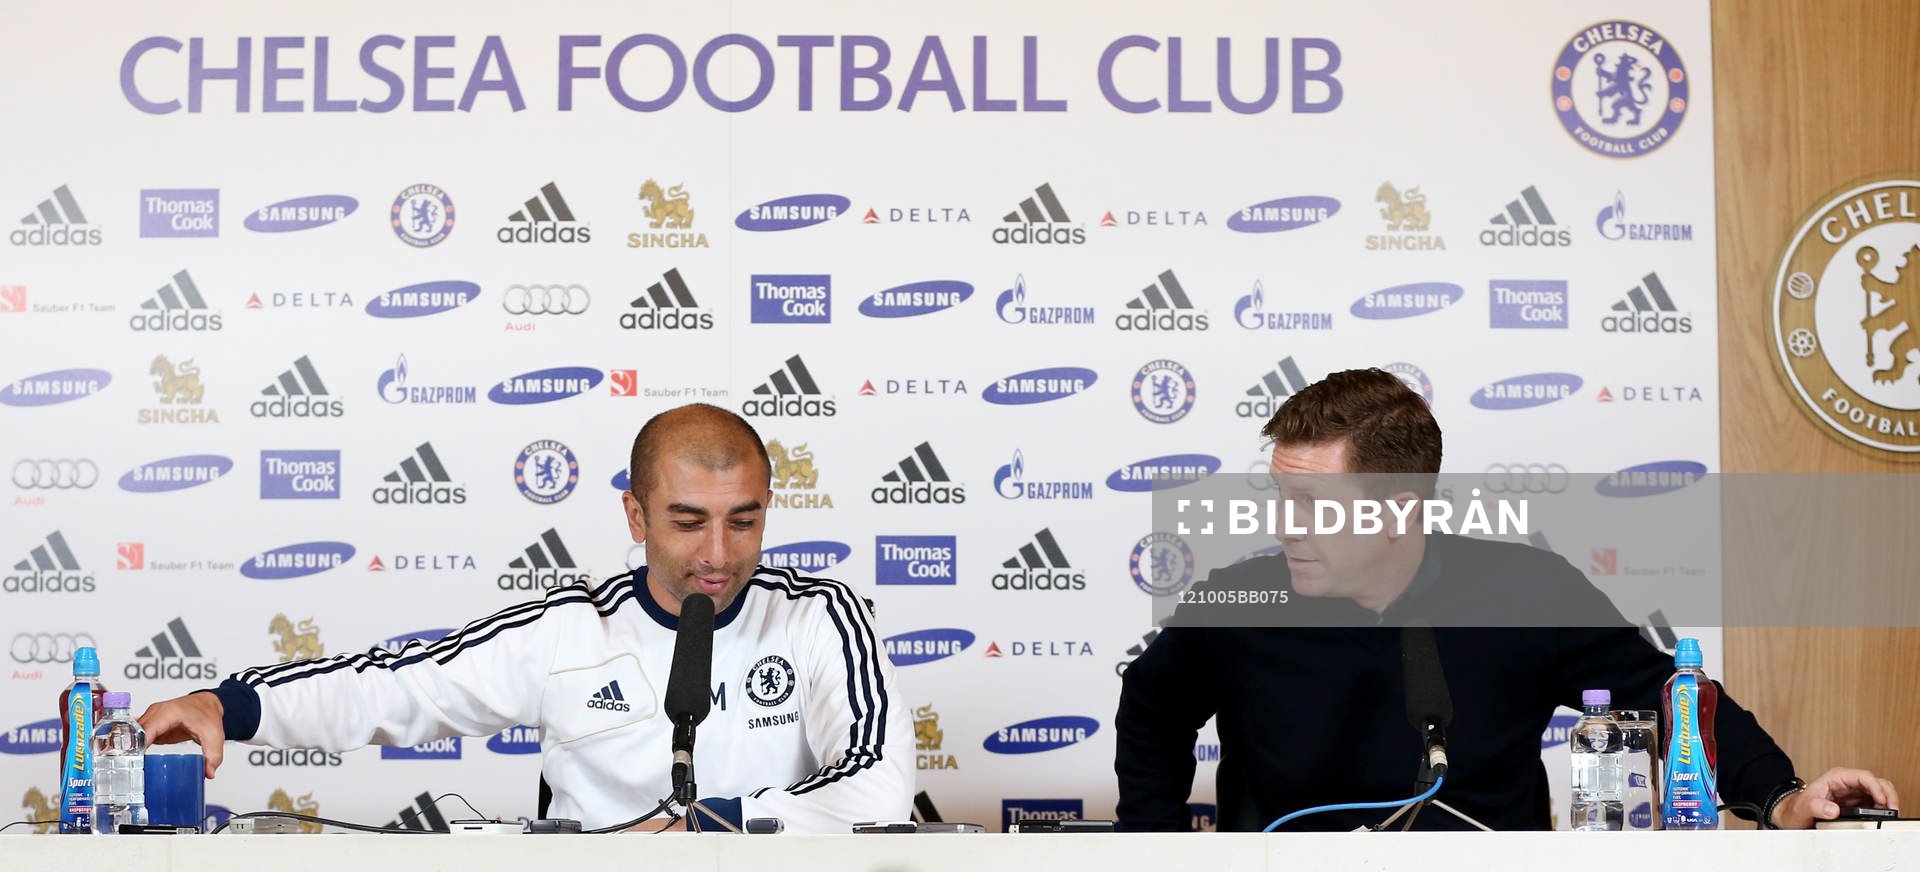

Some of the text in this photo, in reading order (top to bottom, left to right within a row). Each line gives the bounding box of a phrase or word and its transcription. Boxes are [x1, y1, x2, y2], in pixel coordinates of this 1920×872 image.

[1572, 23, 1664, 55] CHELSEA
[119, 33, 1344, 115] CHELSEA FOOTBALL CLUB
[1574, 126, 1668, 153] FOOTBALL CLUB
[145, 197, 214, 214] Thomas
[750, 206, 837, 221] SAMSUNG
[259, 206, 345, 222] SAMSUNG
[890, 208, 971, 222] DELTA
[1128, 211, 1208, 225] DELTA
[1241, 207, 1328, 222] SAMSUNG
[1821, 192, 1920, 243] CHEL
[172, 214, 213, 231] Cook
[10, 224, 102, 246] adidas
[497, 222, 591, 243] adidas
[992, 222, 1086, 244] adidas
[1480, 224, 1571, 247] adidas
[1629, 223, 1693, 241] GAZPROM
[627, 233, 709, 249] SINGHA
[1365, 235, 1446, 251] SINGHA
[756, 282, 826, 300] Thomas
[1494, 288, 1563, 305] Thomas
[33, 303, 116, 312] Sauber F1 Team
[273, 293, 353, 307] DELTA
[380, 292, 468, 307] SAMSUNG
[873, 292, 960, 307] SAMSUNG
[1364, 294, 1451, 309] SAMSUNG
[782, 300, 826, 317] Cook
[1029, 307, 1095, 324] GAZPROM
[1521, 305, 1562, 322] Cook
[130, 309, 222, 331] adidas
[505, 321, 536, 332] Audi
[620, 307, 713, 330] adidas
[1115, 309, 1208, 331] adidas
[1268, 312, 1333, 330] GAZPROM
[1601, 311, 1692, 334] adidas
[12, 380, 98, 396] SAMSUNG
[502, 378, 590, 394] SAMSUNG
[644, 387, 729, 397] Sauber F1 Team
[887, 380, 967, 394] DELTA
[997, 378, 1085, 394] SAMSUNG
[1484, 384, 1570, 399] SAMSUNG
[1624, 387, 1702, 401] DELTA
[411, 386, 476, 404] GAZPROM
[250, 396, 343, 418] adidas
[742, 395, 836, 417] adidas
[1236, 396, 1276, 418] adi
[1822, 388, 1920, 436] FOOTBAL
[138, 409, 219, 424] SINGHA
[525, 441, 568, 455] CHELSEA
[133, 466, 220, 482] SAMSUNG
[266, 458, 335, 476] Thomas
[1121, 466, 1208, 481] SAMSUNG
[292, 475, 335, 493] Cook
[1609, 472, 1694, 486] SAMSUNG
[372, 482, 466, 504] adidas
[871, 481, 966, 504] adidas
[1027, 482, 1093, 500] GAZPROM
[14, 496, 45, 505] Audi
[767, 493, 834, 509] NGHA
[255, 553, 342, 568] SAMSUNG
[762, 553, 837, 567] AMSUNG
[881, 544, 951, 561] Thomas
[150, 561, 234, 570] Sauber F1 Team
[396, 555, 476, 570] DELTA
[907, 561, 951, 577] Cook
[3, 570, 96, 593] adidas
[992, 567, 1085, 591] adidas
[886, 640, 961, 654] AMSUNG
[1012, 642, 1093, 656] DELTA
[12, 670, 43, 680] Audi
[124, 657, 218, 680] adidas
[587, 698, 630, 712] adidas
[748, 711, 799, 729] SAMSUNG
[8, 728, 63, 743] SAMS
[73, 705, 85, 771] Lucozade
[999, 728, 1086, 743] SAMSUNG
[1678, 697, 1692, 765] Lucozade
[248, 748, 342, 766] adidas
[916, 755, 959, 769] GHA
[68, 776, 92, 788] Sport
[1672, 770, 1699, 783] Sport
[1008, 808, 1077, 825] Thomas
